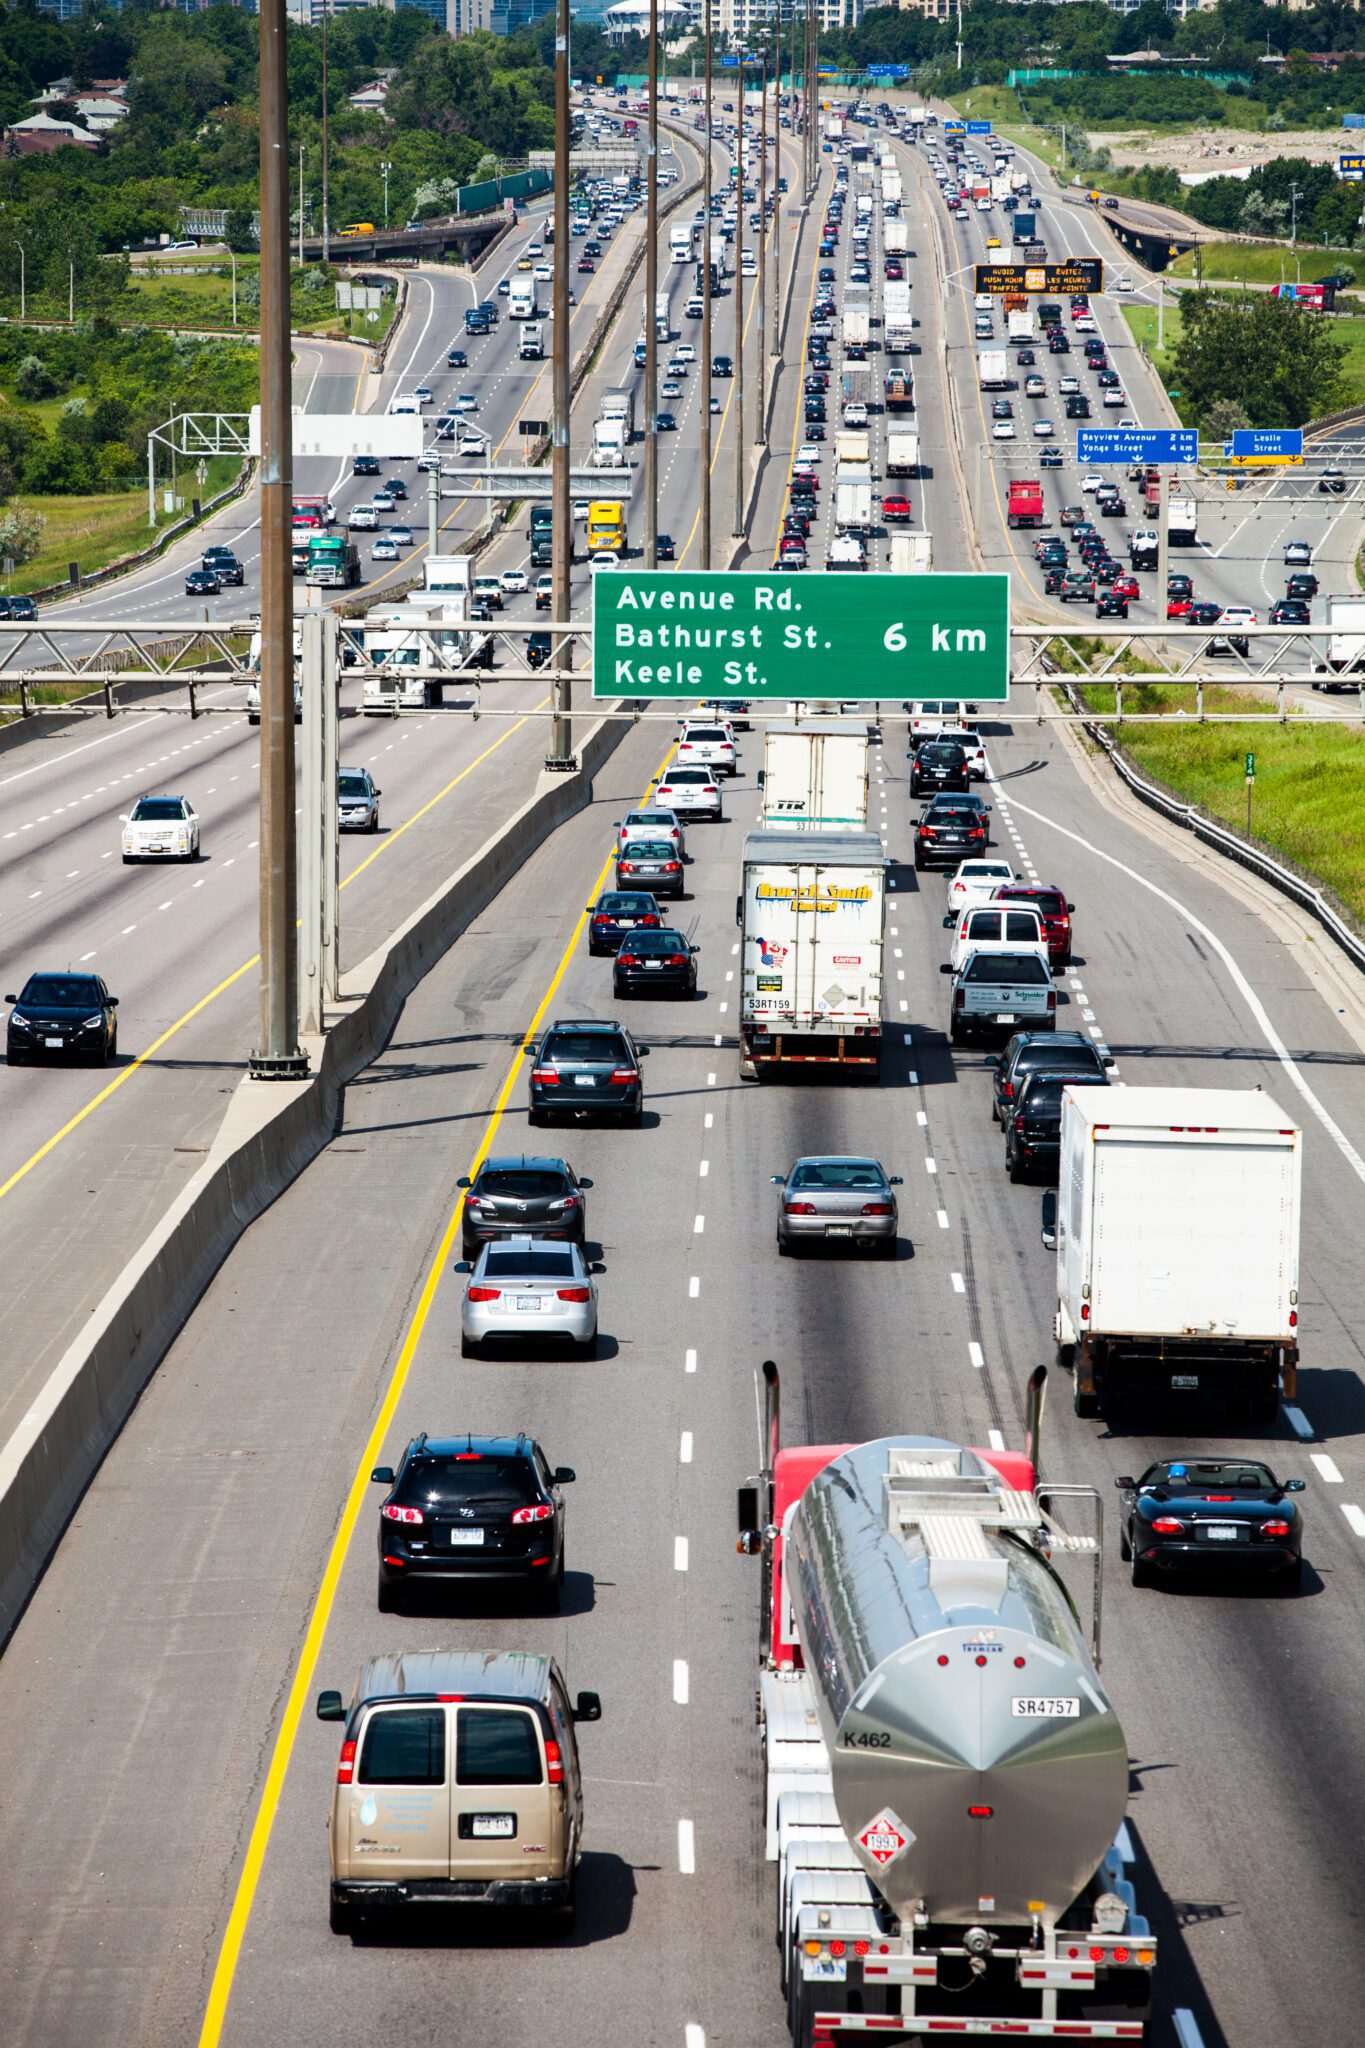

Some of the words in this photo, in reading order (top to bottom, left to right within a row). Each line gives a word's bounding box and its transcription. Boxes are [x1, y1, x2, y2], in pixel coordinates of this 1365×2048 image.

[1082, 433, 1119, 443] Bayview
[1123, 433, 1157, 441] Avenue
[1169, 433, 1177, 441] 2
[1180, 433, 1193, 441] km
[1254, 434, 1281, 442] Leslie
[1082, 444, 1111, 453] Yonge
[1114, 444, 1143, 452] Street
[1169, 444, 1177, 452] 4
[1180, 444, 1193, 452] km
[1254, 444, 1282, 452] Street
[616, 586, 735, 611] Avenue
[755, 587, 802, 611] Rd.
[615, 623, 763, 648] Bathurst
[782, 624, 832, 649] St.
[883, 622, 907, 651] 6
[931, 623, 987, 652] km
[615, 660, 703, 684] Keele
[723, 661, 767, 685] St.
[827, 884, 873, 900] Smith
[834, 956, 860, 964] CAUTION
[1015, 991, 1045, 1001] Schneider
[749, 999, 790, 1009] 53RT159
[1016, 1699, 1074, 1715] SR4757
[843, 1731, 892, 1748] K462
[871, 1835, 896, 1849] 1993
[879, 1852, 886, 1861] 3
